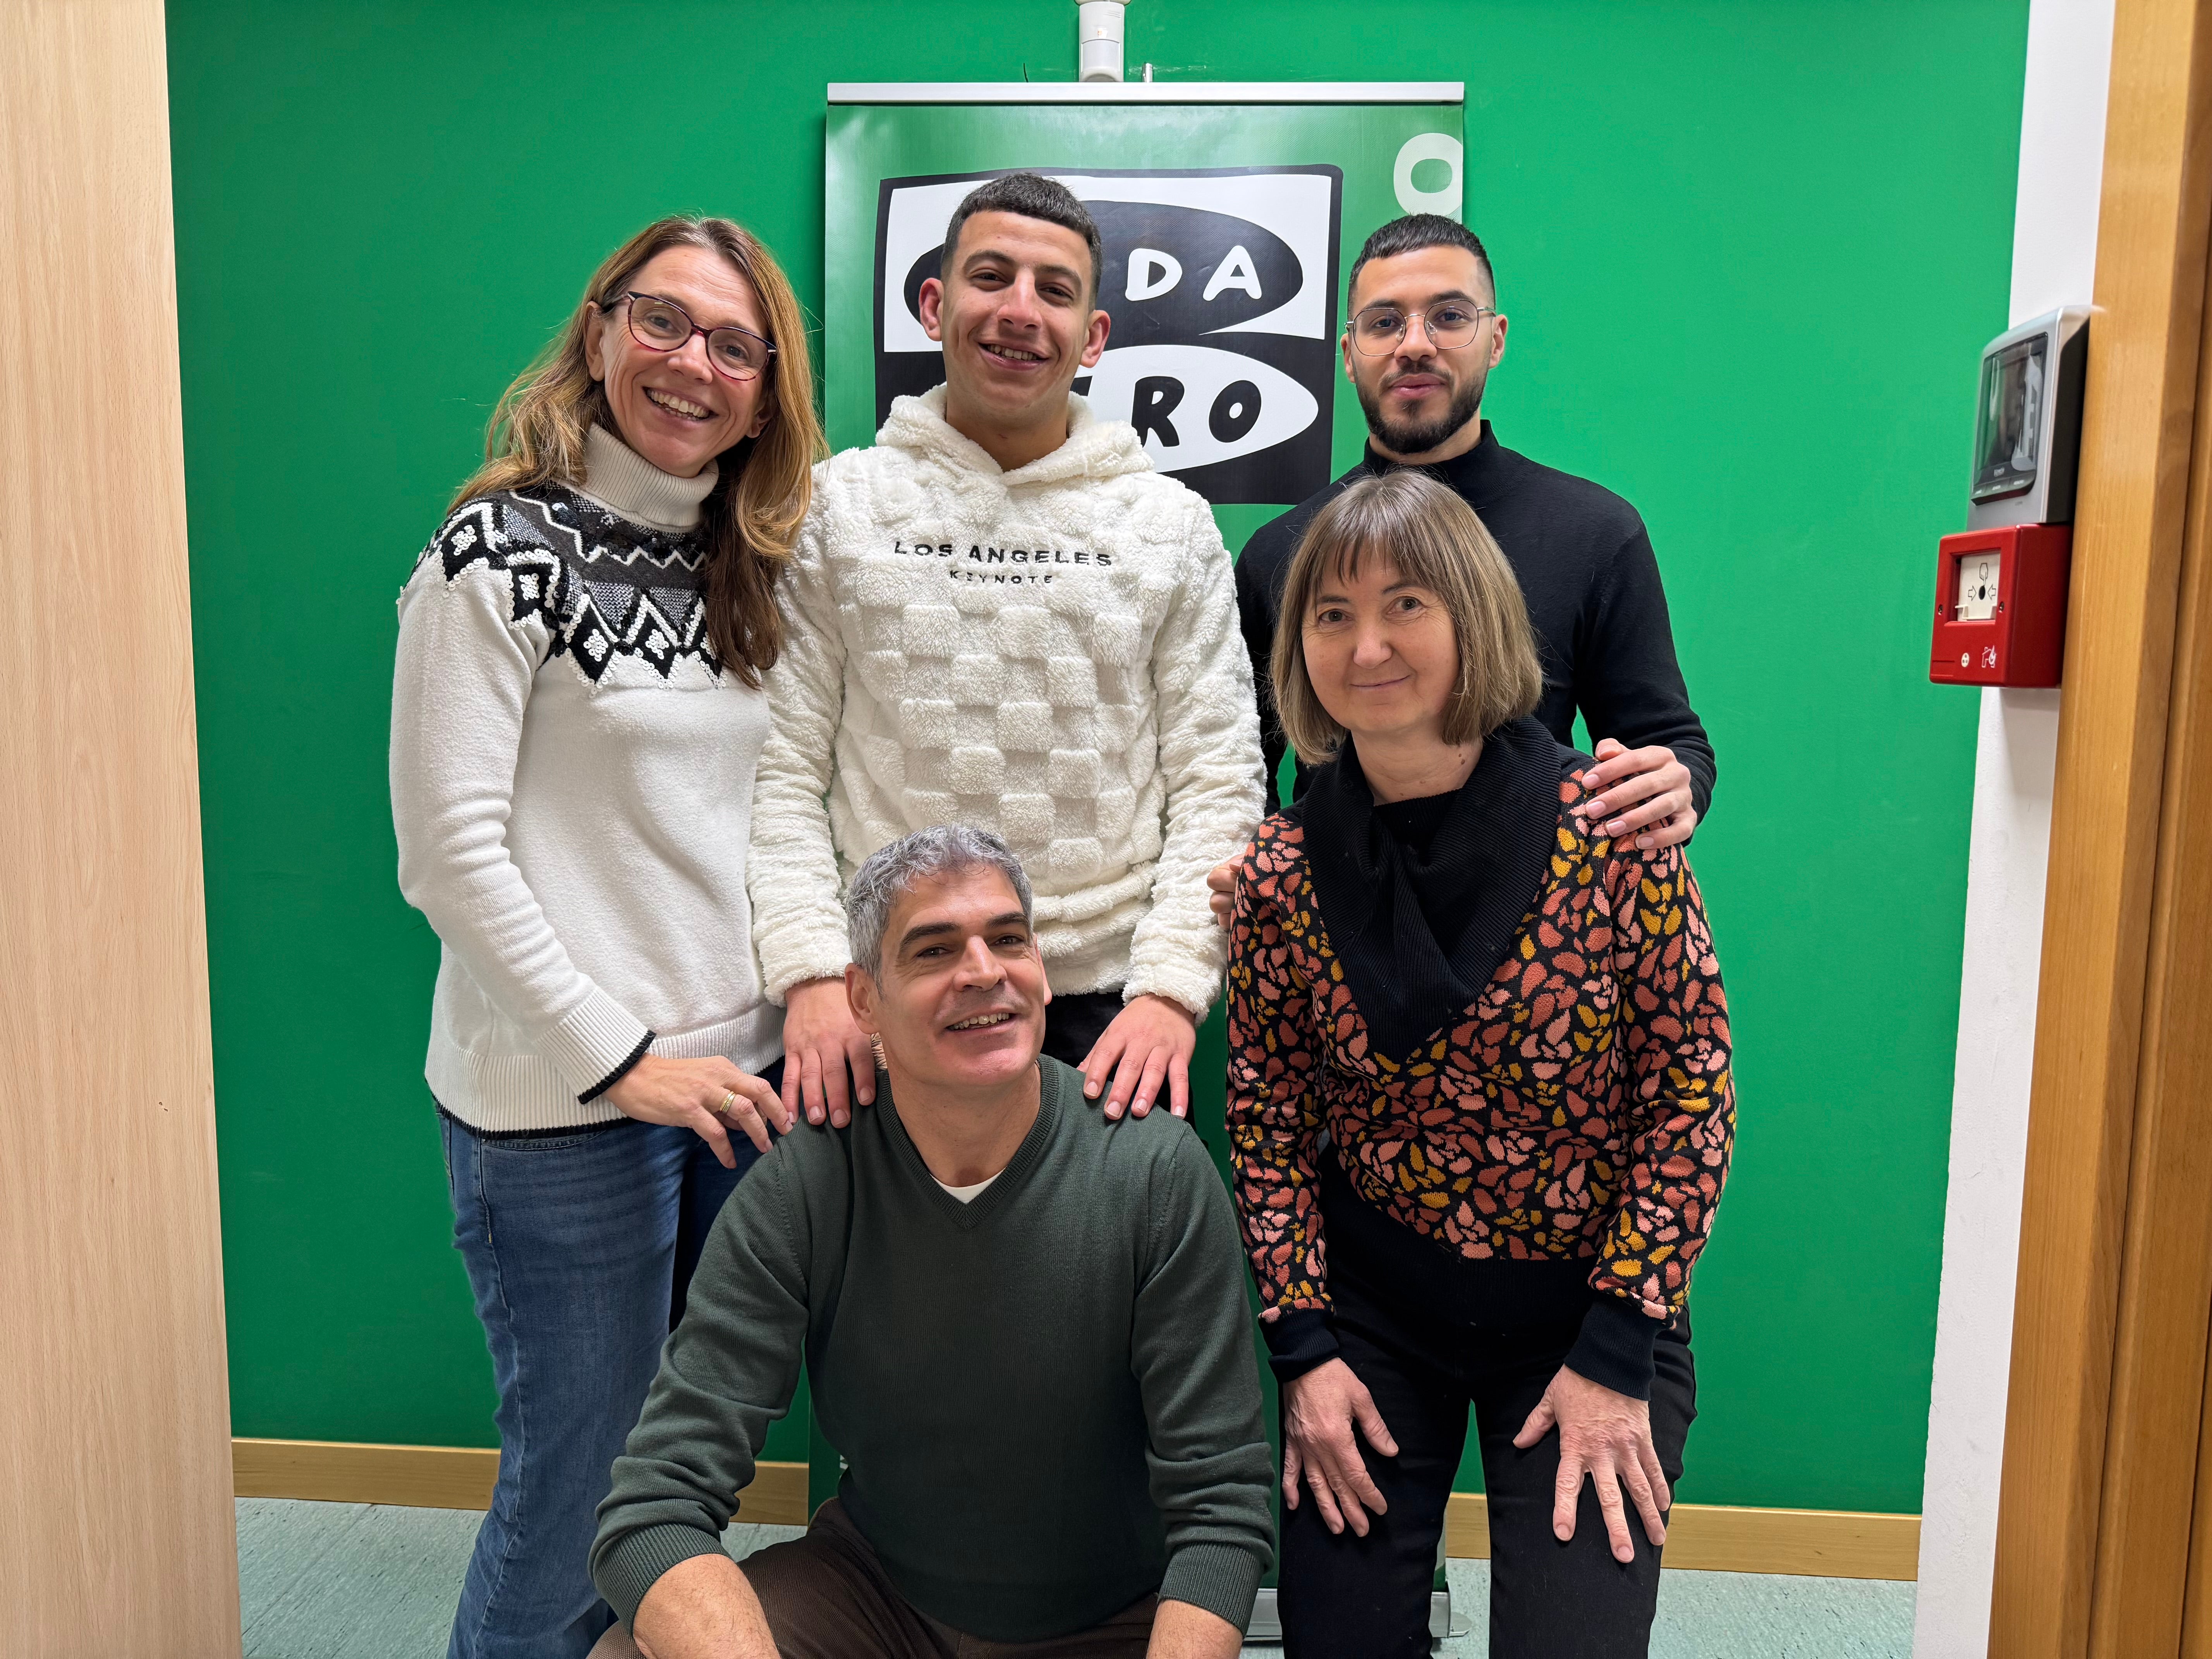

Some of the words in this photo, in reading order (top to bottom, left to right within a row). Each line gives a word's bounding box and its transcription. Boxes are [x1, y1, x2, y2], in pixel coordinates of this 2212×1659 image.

[1125, 245, 1262, 301] DA
[1070, 376, 1261, 448] RO
[894, 541, 952, 557] LOS
[969, 545, 1111, 566] ANGELES
[950, 570, 1053, 584] KEYNOTE
